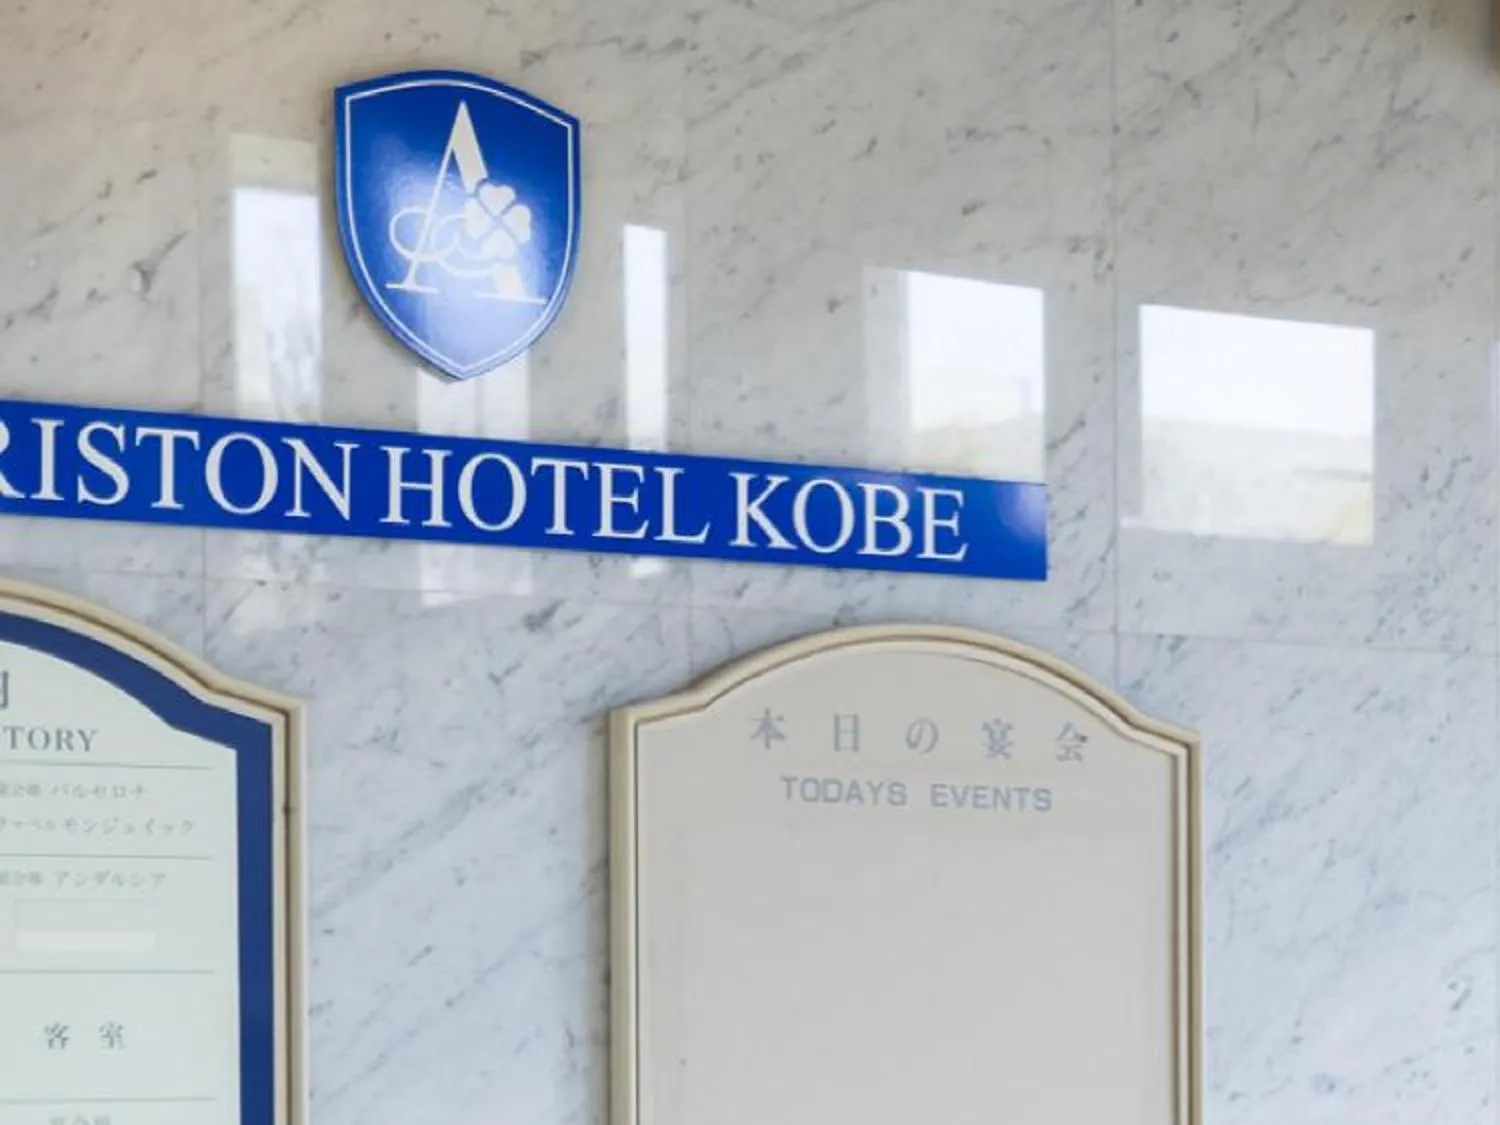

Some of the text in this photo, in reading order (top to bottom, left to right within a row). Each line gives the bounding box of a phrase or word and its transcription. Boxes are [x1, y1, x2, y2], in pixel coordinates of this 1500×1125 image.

[380, 446, 710, 543] HOTEL
[728, 474, 969, 562] KOBE
[751, 706, 1088, 762] 本日の宴会
[781, 776, 1053, 812] TODAYS EVENTS
[43, 1021, 126, 1050] 客室
